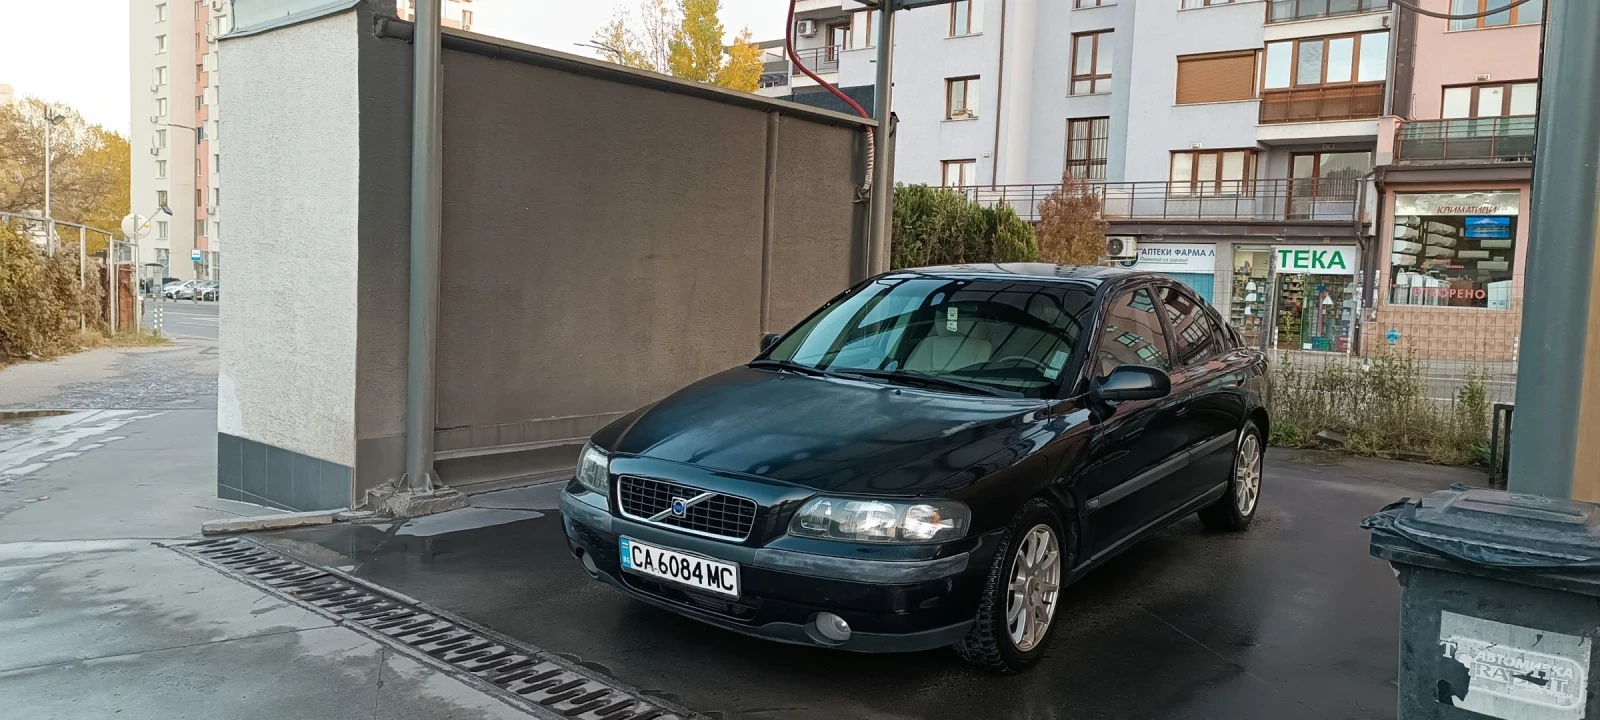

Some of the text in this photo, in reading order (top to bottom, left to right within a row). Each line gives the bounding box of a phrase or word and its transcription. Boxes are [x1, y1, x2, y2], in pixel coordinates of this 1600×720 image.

[1437, 205, 1498, 214] КЛИМАТИЦИ
[1141, 248, 1172, 256] АПТЕКИ
[1174, 249, 1206, 257] ФАРМА
[1277, 249, 1347, 270] ТЕКА
[1411, 287, 1486, 299] ОТВОРЕНО
[632, 545, 734, 591] CA 6084 MC
